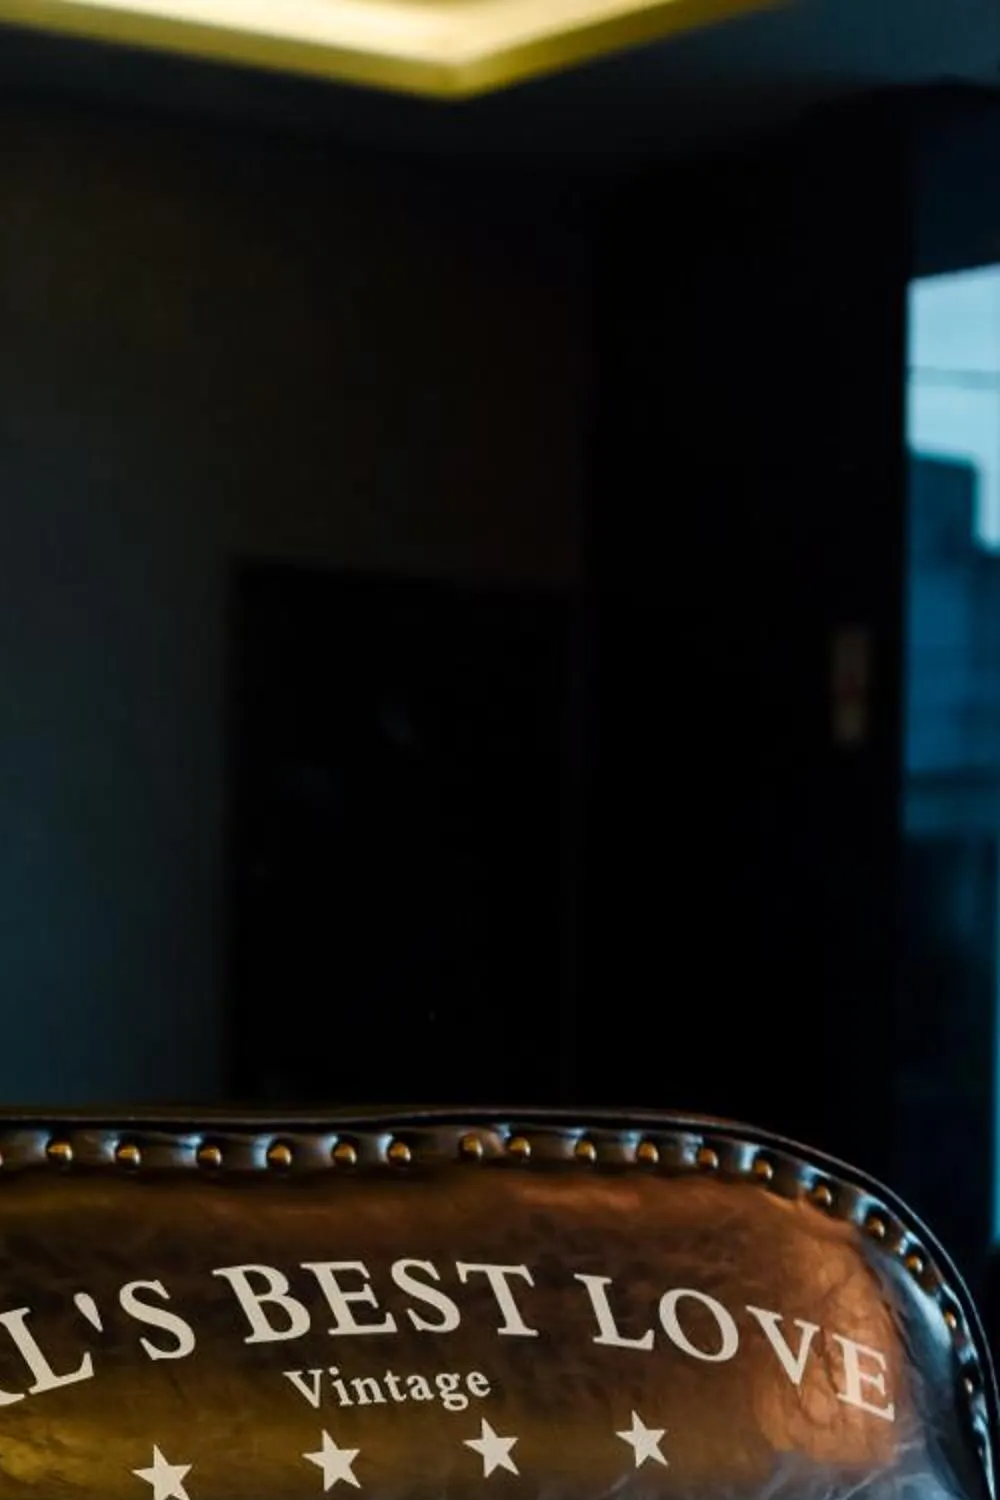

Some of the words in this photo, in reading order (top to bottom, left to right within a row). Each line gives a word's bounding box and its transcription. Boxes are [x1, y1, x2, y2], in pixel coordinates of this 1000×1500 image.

[213, 1259, 537, 1343] BEST
[575, 1273, 894, 1421] LOVE
[284, 1366, 491, 1411] Vintage
